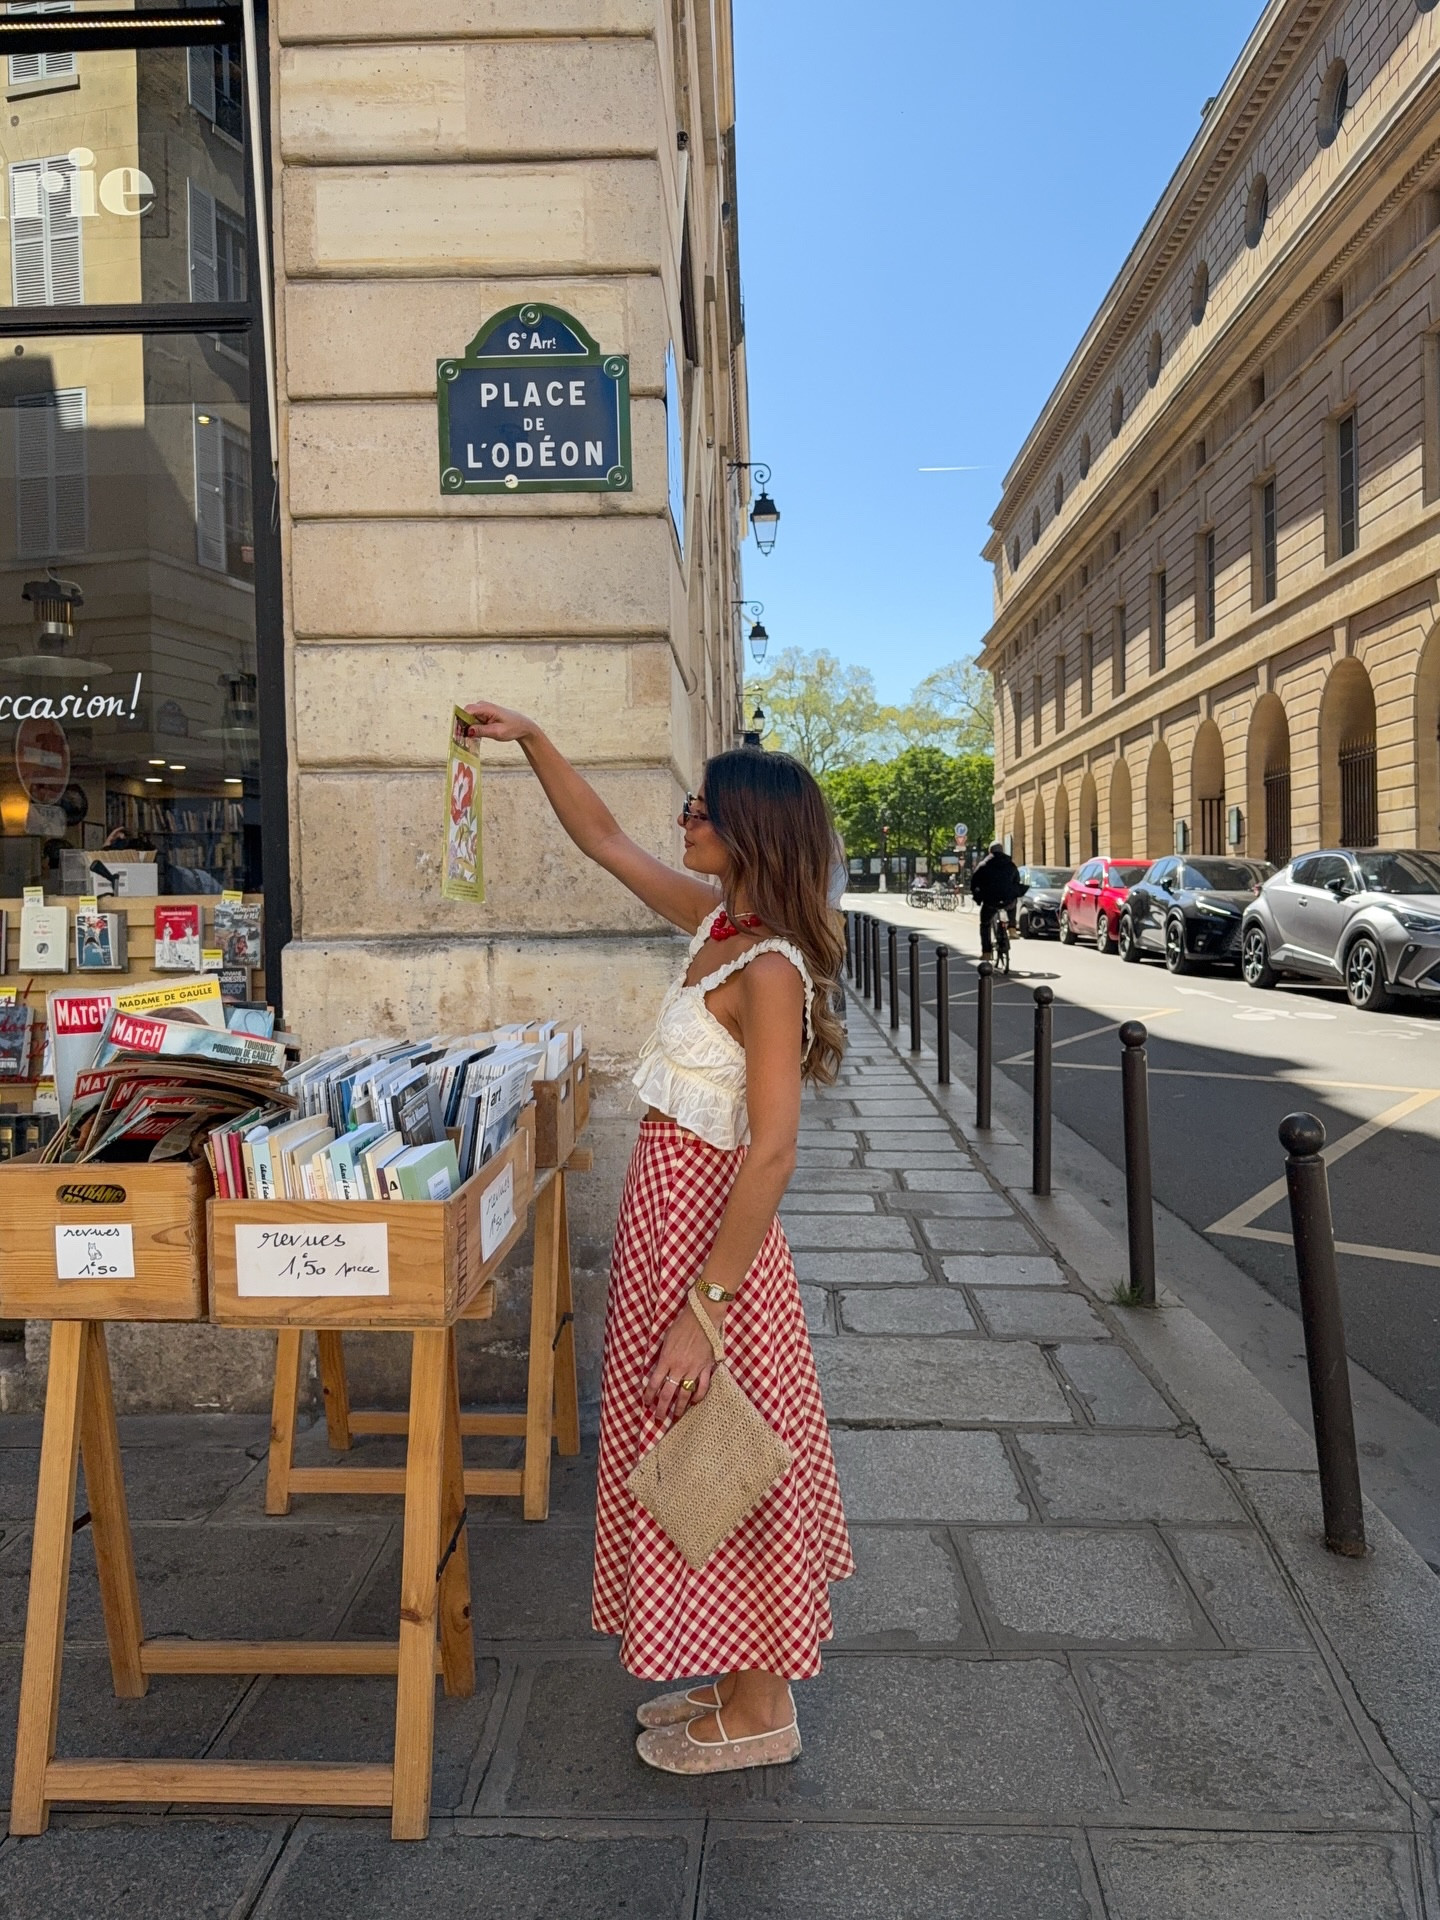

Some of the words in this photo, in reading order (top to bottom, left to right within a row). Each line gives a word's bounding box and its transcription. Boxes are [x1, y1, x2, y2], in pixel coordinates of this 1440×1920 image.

[0, 147, 154, 217] rie
[480, 381, 586, 408] PLACE
[523, 418, 545, 431] DE
[467, 435, 603, 468] L'ODÉON
[119, 996, 160, 1008] MADAME
[179, 987, 213, 999] GAULLE
[56, 998, 109, 1027] MATCH
[112, 1018, 164, 1049] MATCH
[212, 1043, 243, 1058] POURQUOI
[243, 1048, 250, 1058] DE
[252, 1050, 275, 1062] GAULLE
[78, 1076, 111, 1095] MAT
[64, 1228, 120, 1237] revues
[257, 1232, 346, 1249] revues
